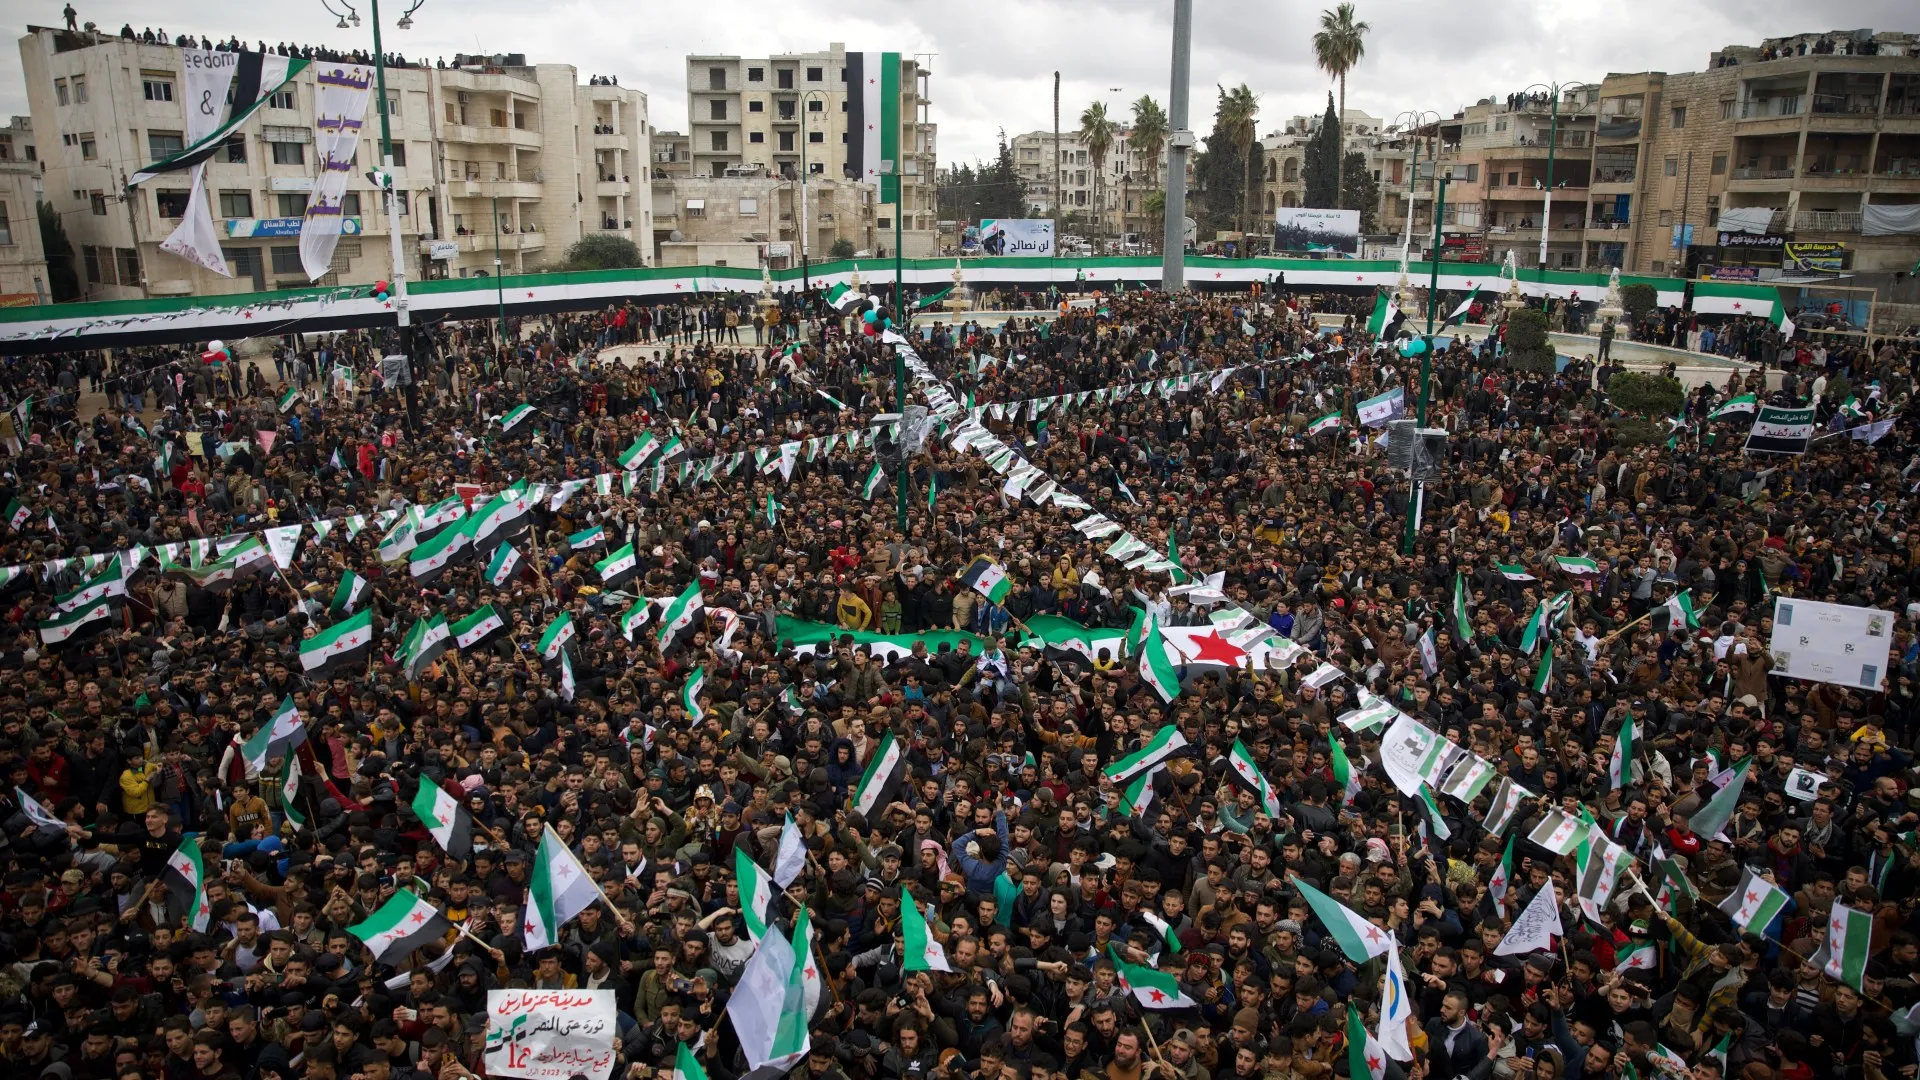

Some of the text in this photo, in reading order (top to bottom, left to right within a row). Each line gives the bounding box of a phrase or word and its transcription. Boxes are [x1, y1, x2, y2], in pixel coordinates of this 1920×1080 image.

[317, 67, 375, 91] الشعب
[201, 90, 215, 116] &
[263, 220, 300, 229] لطب الأسنان
[1010, 240, 1049, 253] لن نصالح
[1793, 243, 1813, 251] القمة
[1768, 413, 1789, 421] النصر
[498, 991, 593, 1015] مدينة عزمارين
[529, 1016, 604, 1037] ثورة حتى النصر
[567, 1048, 595, 1066] شباب
[592, 1051, 611, 1073] تجمع
